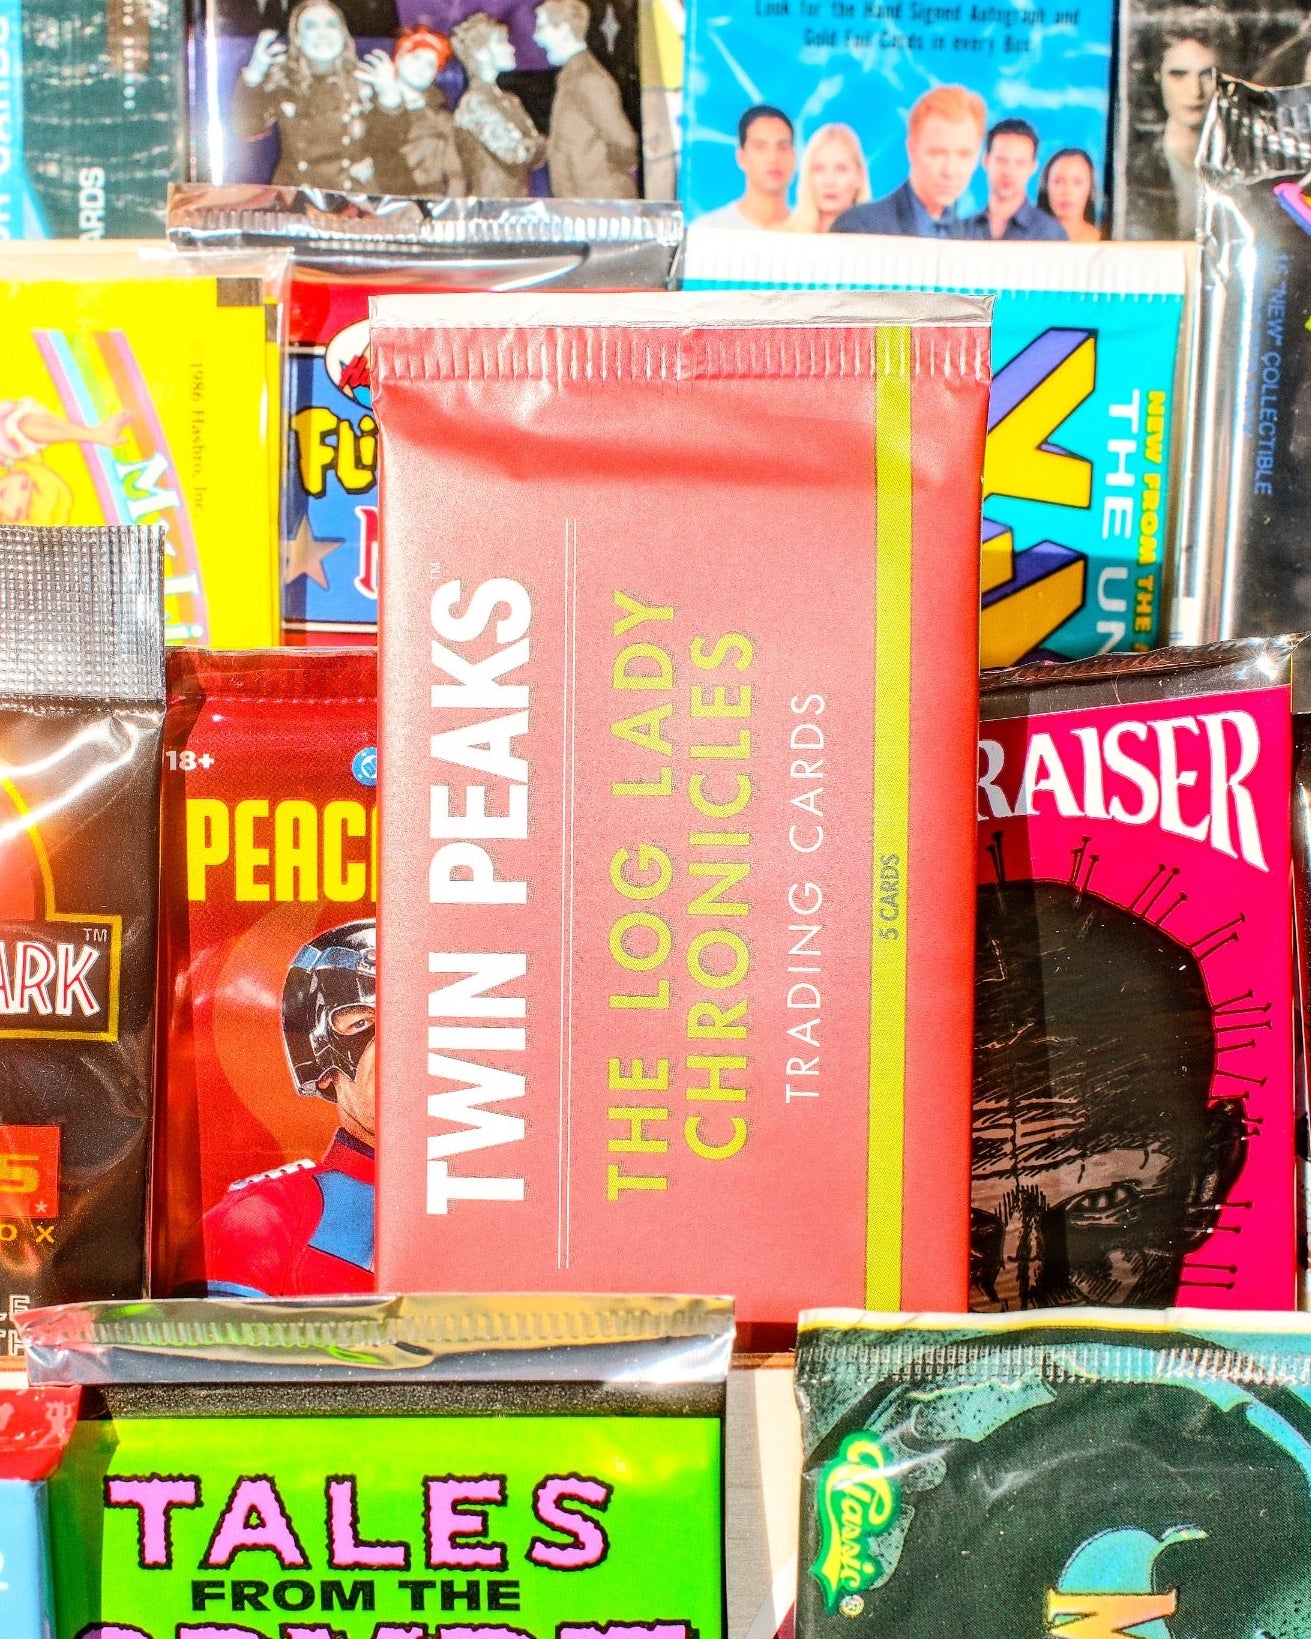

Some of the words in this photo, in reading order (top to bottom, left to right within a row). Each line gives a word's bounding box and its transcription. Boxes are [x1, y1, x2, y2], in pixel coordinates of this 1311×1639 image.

[190, 363, 204, 401] 1986
[1145, 389, 1167, 464] NEW
[1254, 352, 1282, 495] COLLECTIBLE
[1101, 388, 1140, 540] THE
[1138, 472, 1161, 565] FROM
[1133, 574, 1154, 633] THE
[428, 576, 534, 905] PEAKS
[610, 589, 676, 798] LADY
[165, 750, 215, 771] 18+
[789, 692, 826, 854] CARDS
[186, 798, 378, 903] PEAC
[683, 630, 755, 1161] CHRONICLES
[878, 853, 900, 922] CARDS
[83, 928, 108, 942] TM
[608, 845, 674, 1010] LOG
[877, 928, 900, 941] 5
[785, 879, 823, 1104] TRADING
[425, 952, 527, 1215] TWIN
[607, 1056, 669, 1202] THE
[104, 1473, 614, 1572] TALES
[821, 1440, 893, 1591] Classic
[191, 1579, 376, 1612] FROM
[398, 1579, 522, 1612] THE
